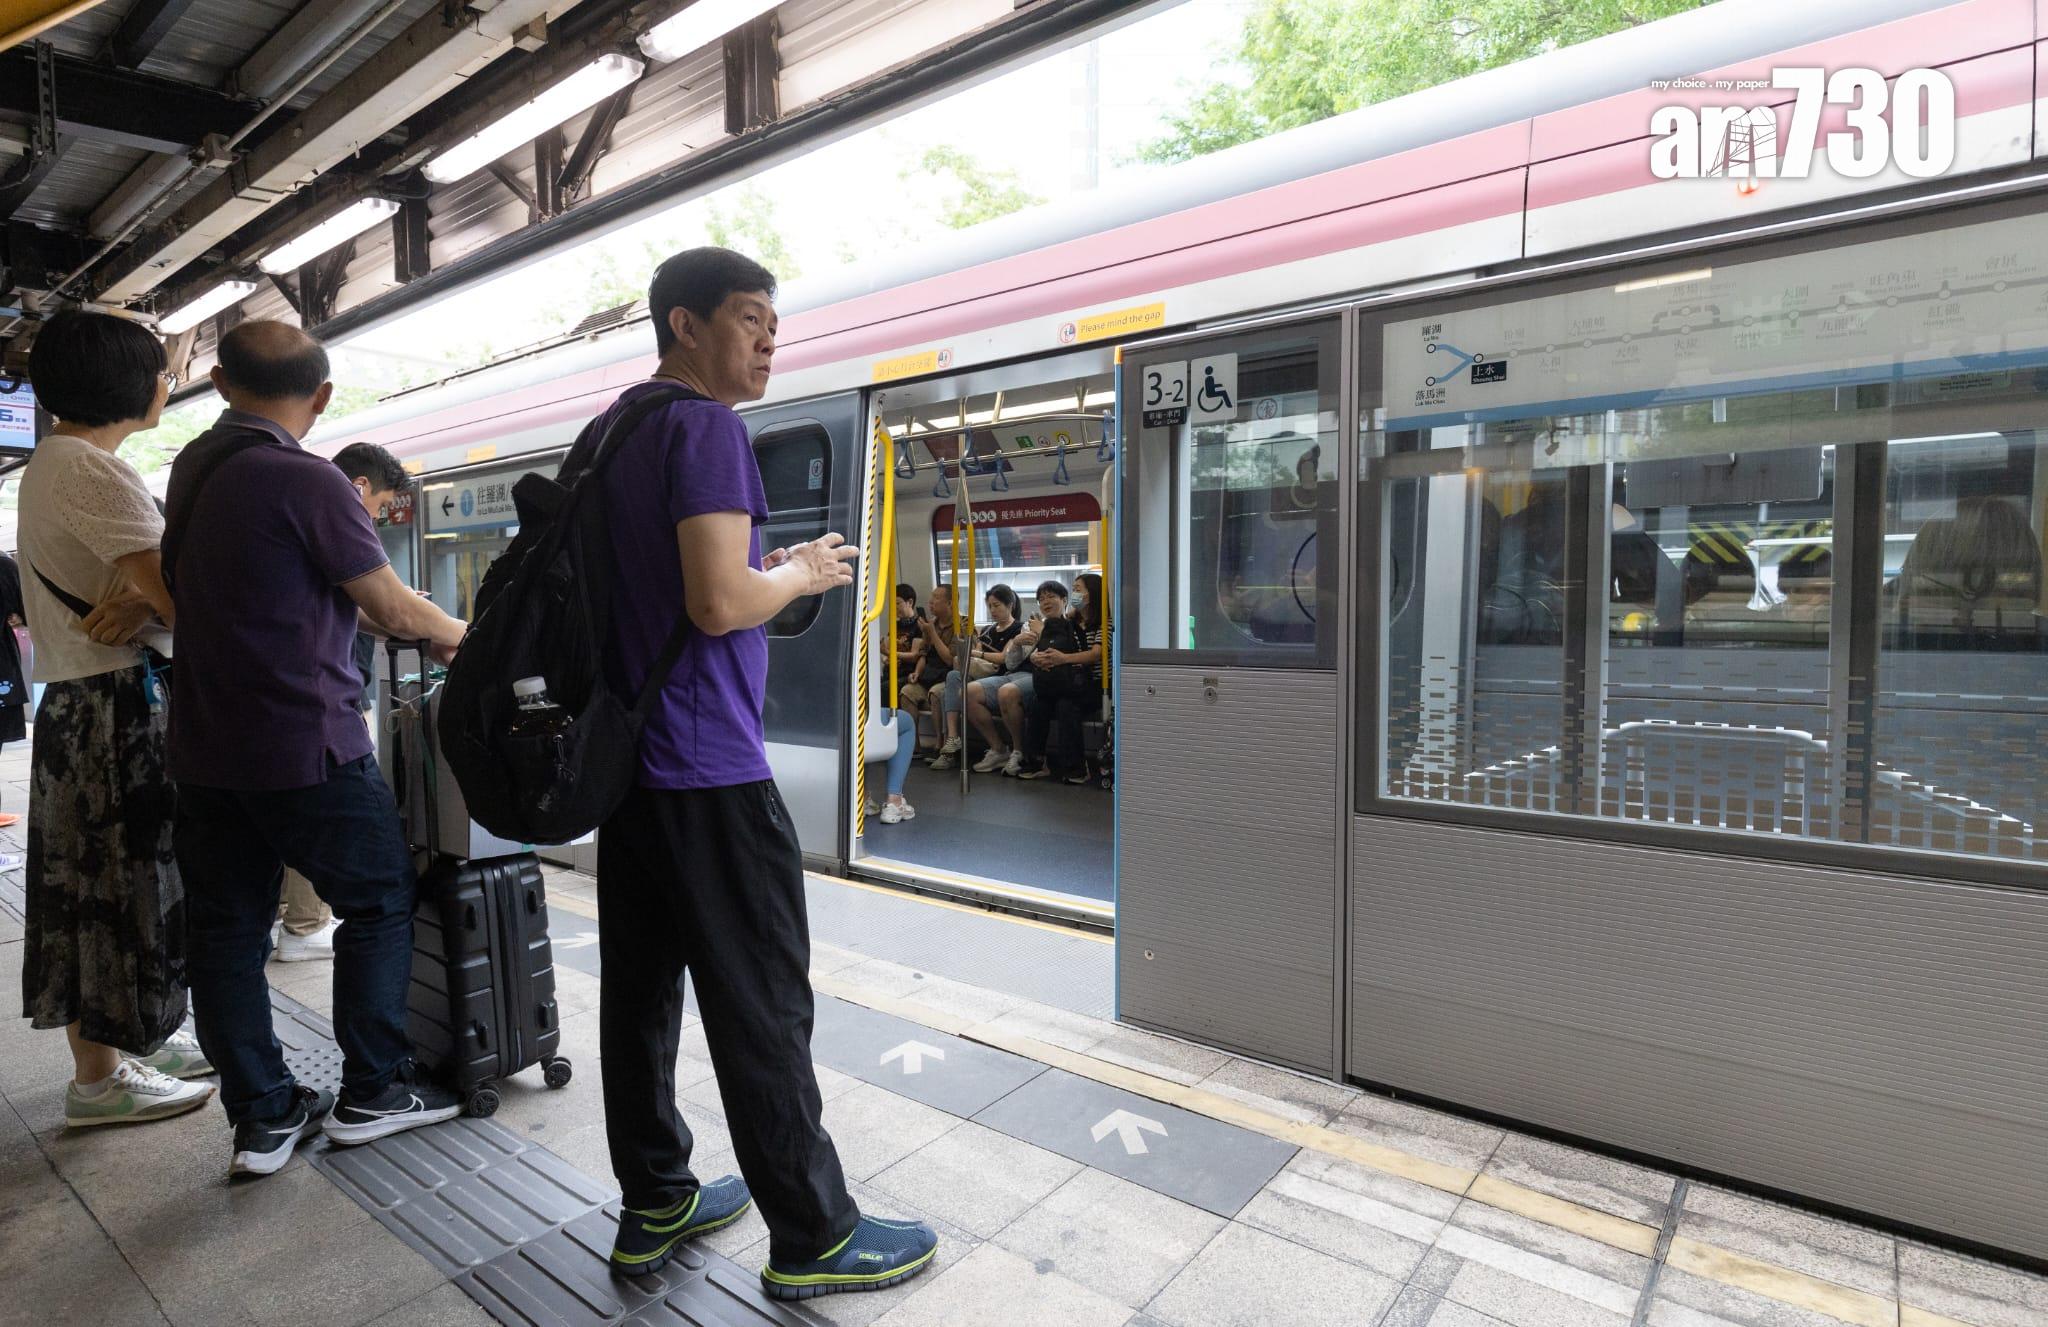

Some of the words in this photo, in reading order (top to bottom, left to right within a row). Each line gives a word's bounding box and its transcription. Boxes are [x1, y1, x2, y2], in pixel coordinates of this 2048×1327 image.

[1080, 321, 1105, 333] Please
[1107, 316, 1127, 329] mind
[1129, 314, 1143, 324] the
[1144, 311, 1161, 323] gap
[1474, 364, 1495, 377] 上水
[1146, 372, 1184, 406] 3-2
[1416, 388, 1445, 400] 落馬洲
[1025, 508, 1049, 518] Priority
[1050, 507, 1066, 515] Seat
